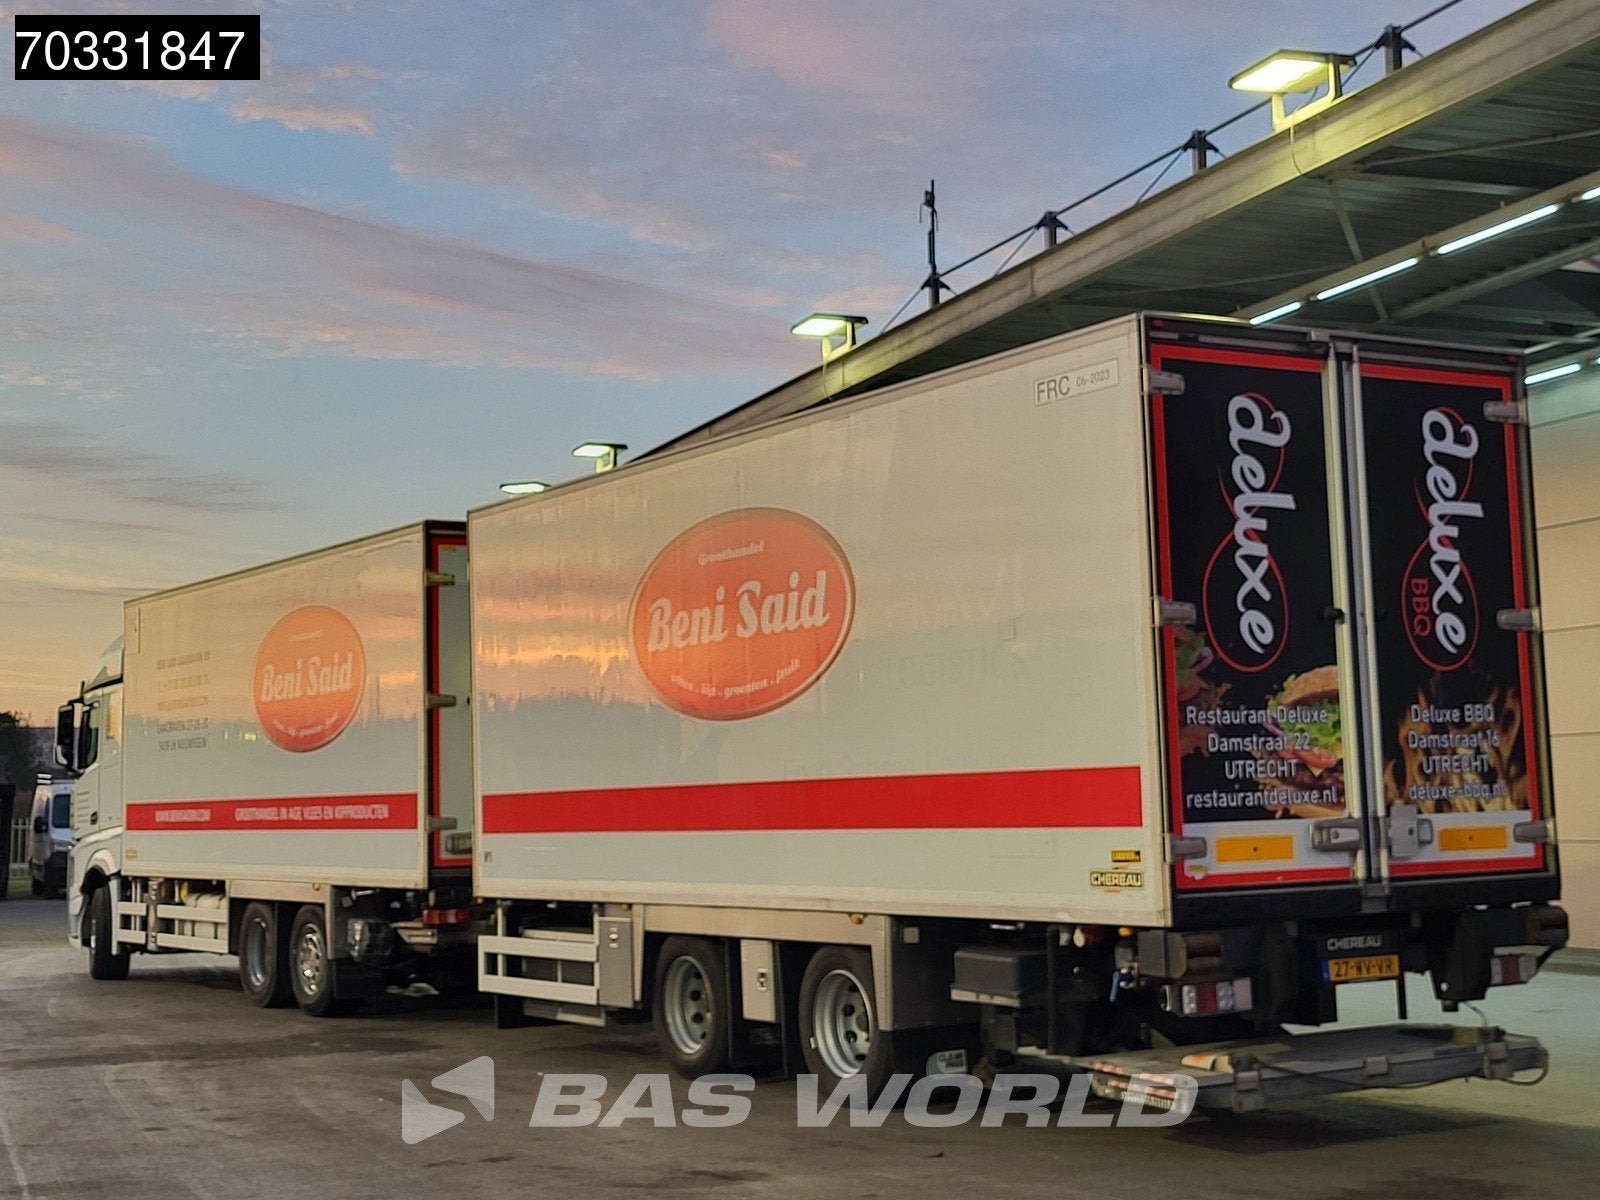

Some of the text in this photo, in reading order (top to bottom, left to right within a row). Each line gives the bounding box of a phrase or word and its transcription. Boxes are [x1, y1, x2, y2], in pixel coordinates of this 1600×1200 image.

[1036, 375, 1070, 402] FRC
[647, 585, 728, 652] Beni
[736, 570, 830, 639] Said
[1410, 577, 1432, 637] BBQ
[260, 657, 303, 703] Beni
[305, 651, 353, 696] Said
[1186, 704, 1329, 727] Restaurant Deluxe
[1410, 703, 1495, 723] Deluxe BBQ
[1207, 733, 1311, 754] Damstraat 22
[1408, 730, 1483, 749] Damstraat
[1224, 759, 1299, 781] UTRECHT
[1422, 754, 1490, 775] UTRECHT
[1186, 786, 1338, 809] restaurantdeluxe.nl
[1091, 872, 1142, 887] CHEREAU
[1326, 934, 1382, 951] CHEREAU
